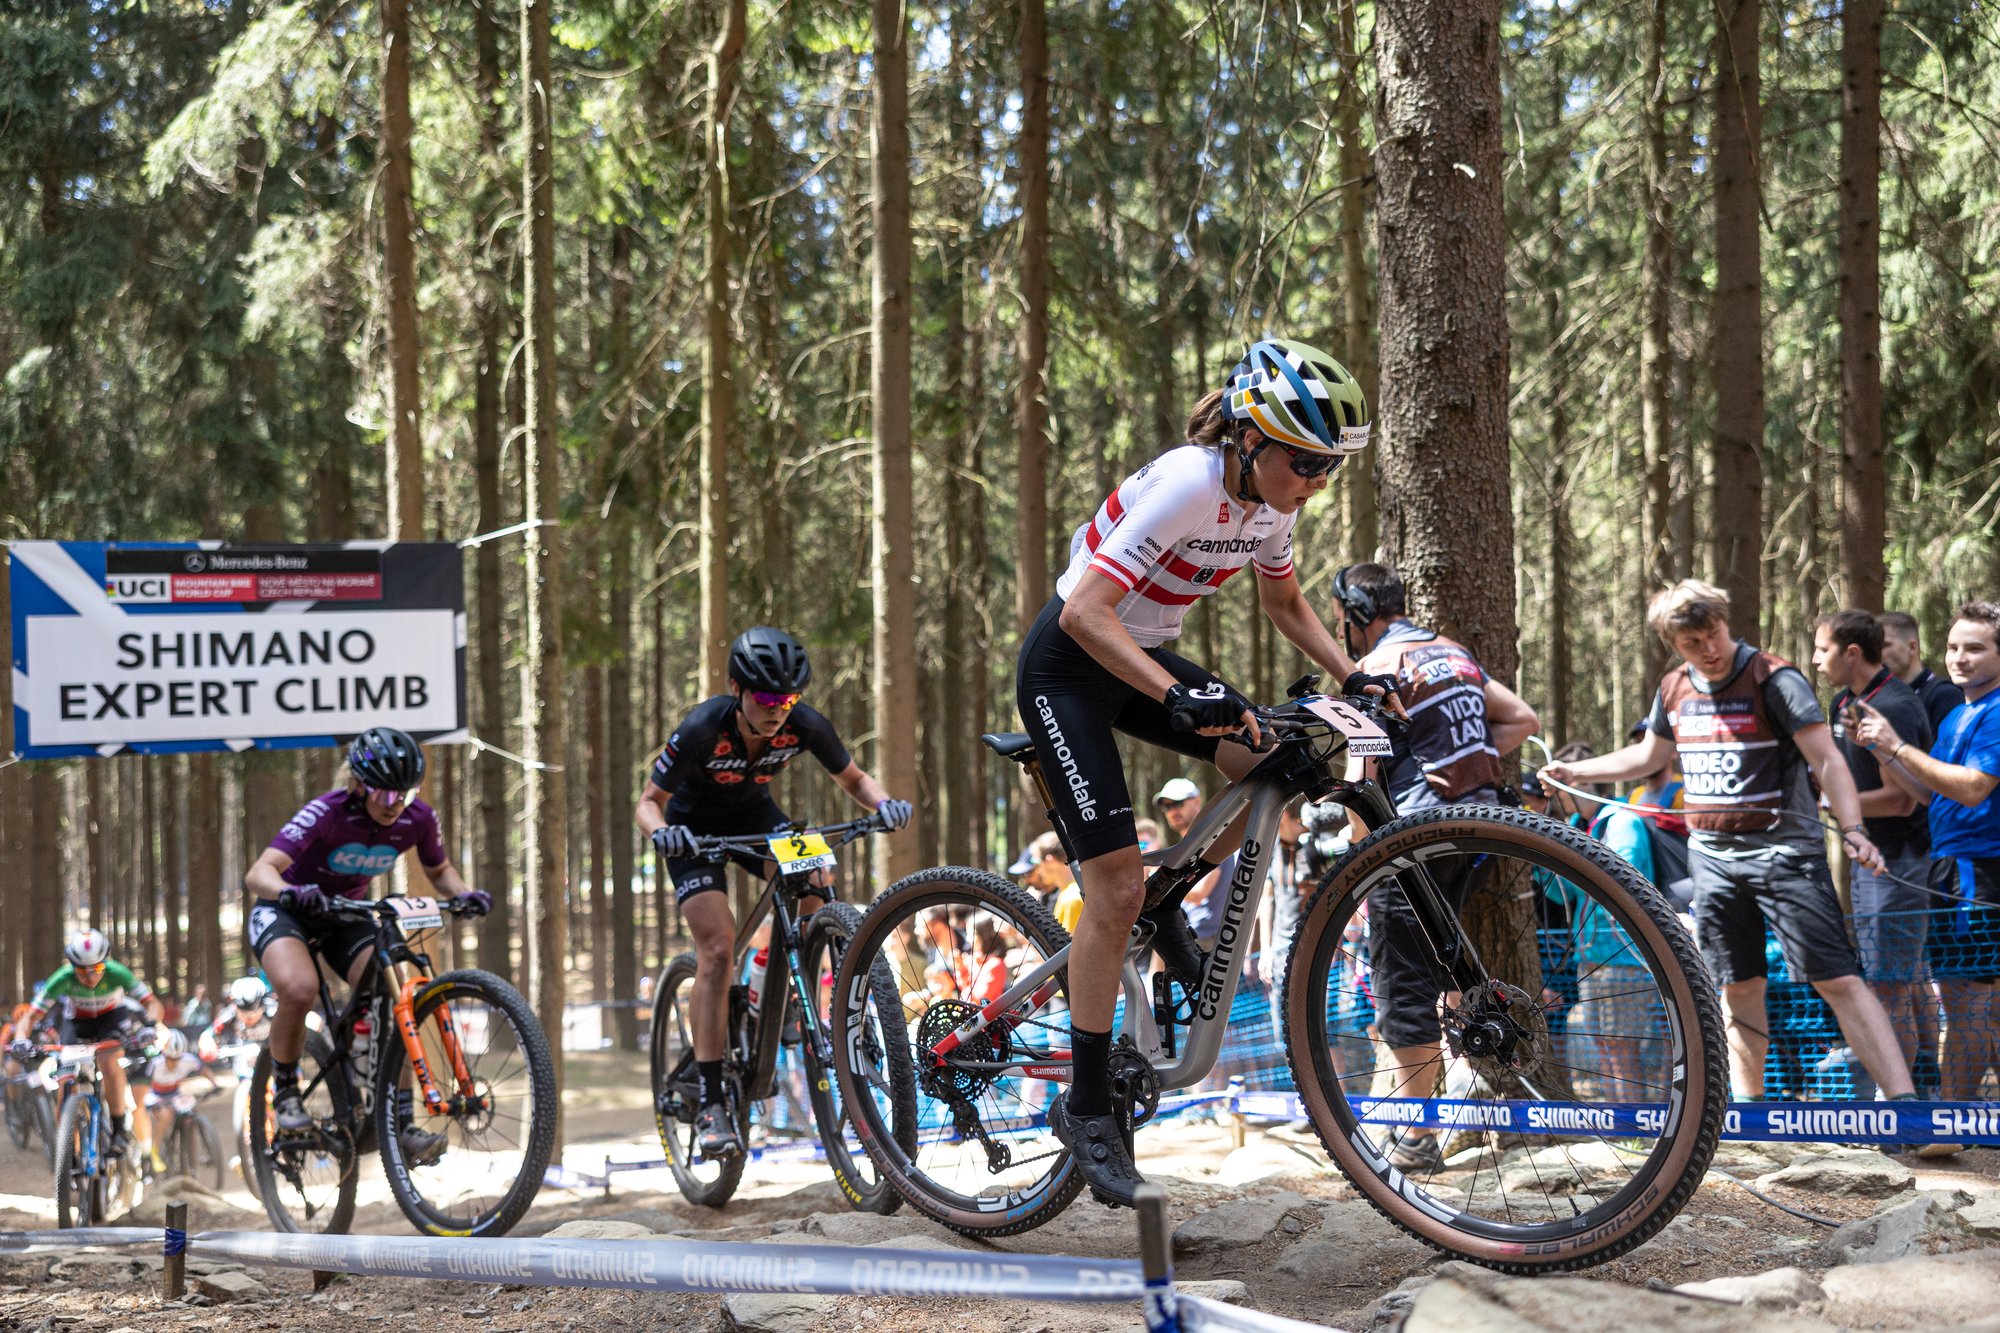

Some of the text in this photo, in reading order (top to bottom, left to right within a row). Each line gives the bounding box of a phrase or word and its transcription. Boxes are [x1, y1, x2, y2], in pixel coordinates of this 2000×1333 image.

[210, 555, 309, 570] Mercedes-Benz
[118, 580, 165, 597] UCI
[116, 627, 375, 670] SHIMANO
[60, 675, 429, 721] EXPERT CLIMB
[1329, 706, 1362, 729] 5
[1035, 695, 1097, 821] cannondale
[1349, 740, 1391, 753] cannondale
[1680, 752, 1741, 773] VIDEO
[791, 839, 812, 857] 2
[1344, 828, 1476, 886] RACING RAY
[403, 897, 427, 911] 13
[1199, 839, 1260, 1021] cannondale
[413, 1058, 431, 1087] FOX
[1031, 1068, 1067, 1076] SHIMANO
[1361, 1101, 1425, 1123] SHIMANO
[1437, 1103, 1512, 1127] SHIMANO
[1528, 1107, 1615, 1130] SHIMANO
[1768, 1109, 1897, 1136] SHIMANO
[386, 1082, 422, 1205] CROSSMAX
[1524, 1183, 1660, 1256] SCHWALBE
